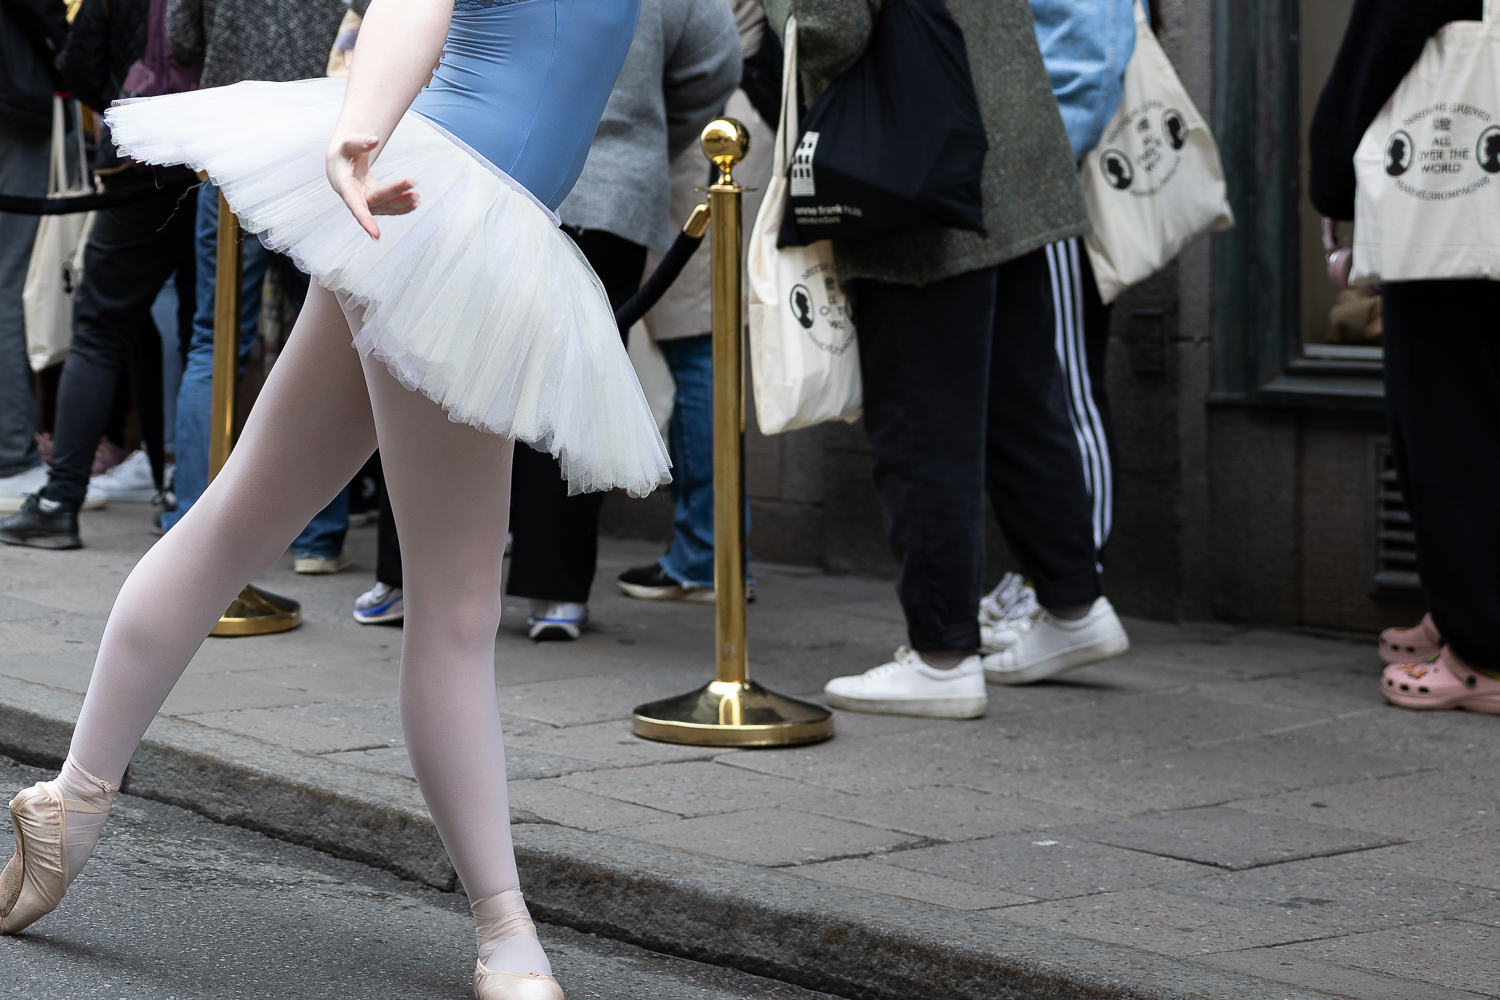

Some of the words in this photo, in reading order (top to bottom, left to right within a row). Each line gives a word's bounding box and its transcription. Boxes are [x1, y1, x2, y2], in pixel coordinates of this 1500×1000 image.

[1433, 136, 1451, 147] ALL
[1449, 148, 1470, 160] THE
[1420, 163, 1463, 174] WORLD
